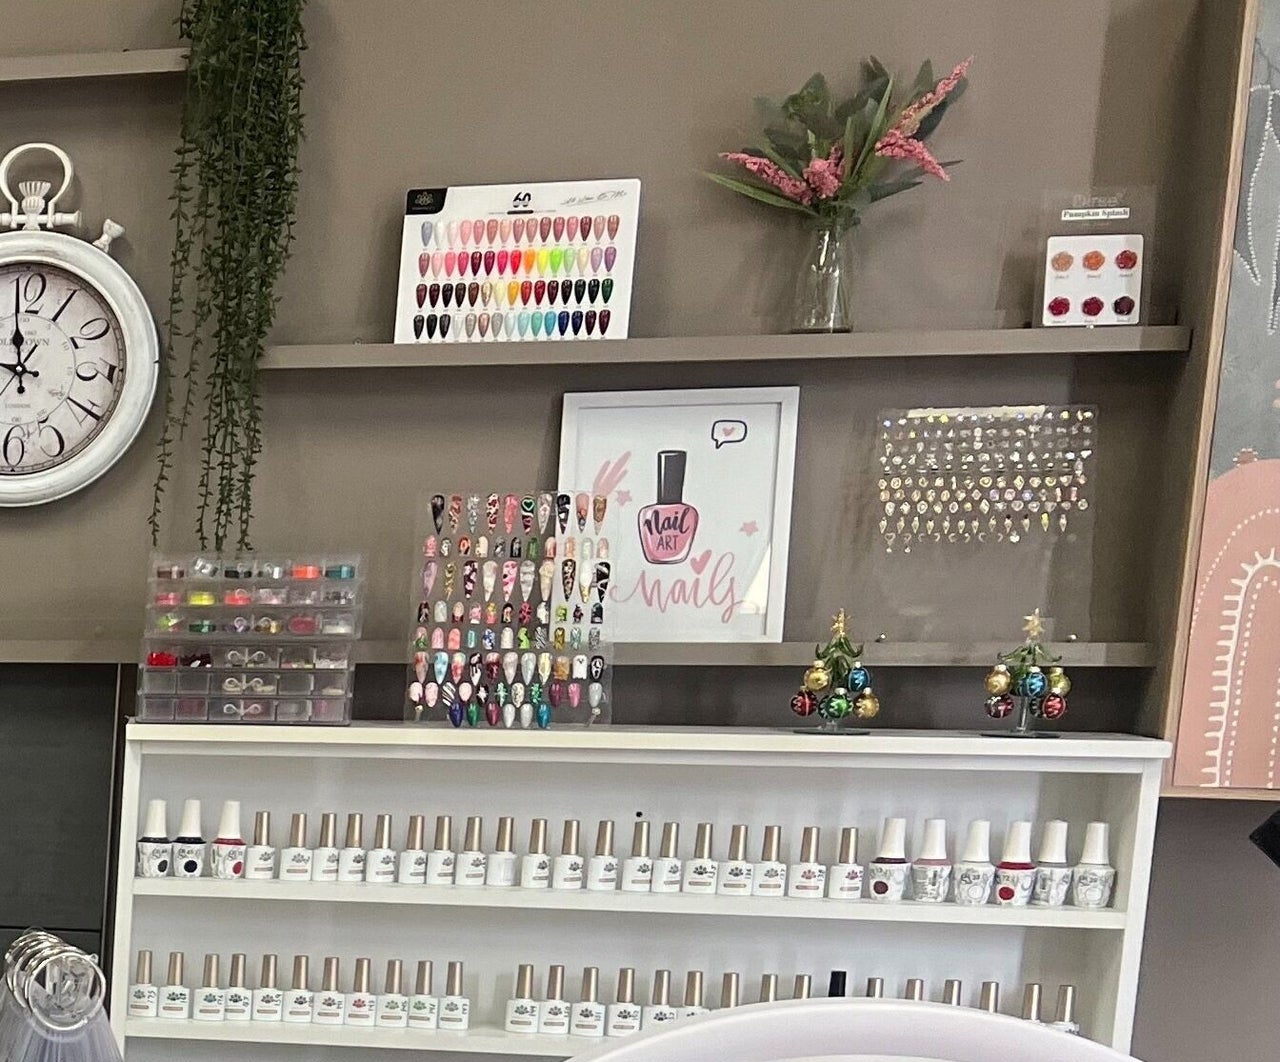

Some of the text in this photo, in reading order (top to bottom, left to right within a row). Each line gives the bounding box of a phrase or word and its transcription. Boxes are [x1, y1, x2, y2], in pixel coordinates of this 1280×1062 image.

[512, 191, 532, 208] 60
[10, 273, 47, 315] 12
[52, 287, 81, 322] 1
[69, 317, 111, 350] 2
[75, 357, 118, 384] 3
[66, 396, 103, 428] 4
[2, 424, 27, 467] 6
[37, 415, 65, 458] 5
[643, 507, 691, 536] Nail
[657, 534, 680, 551] ART
